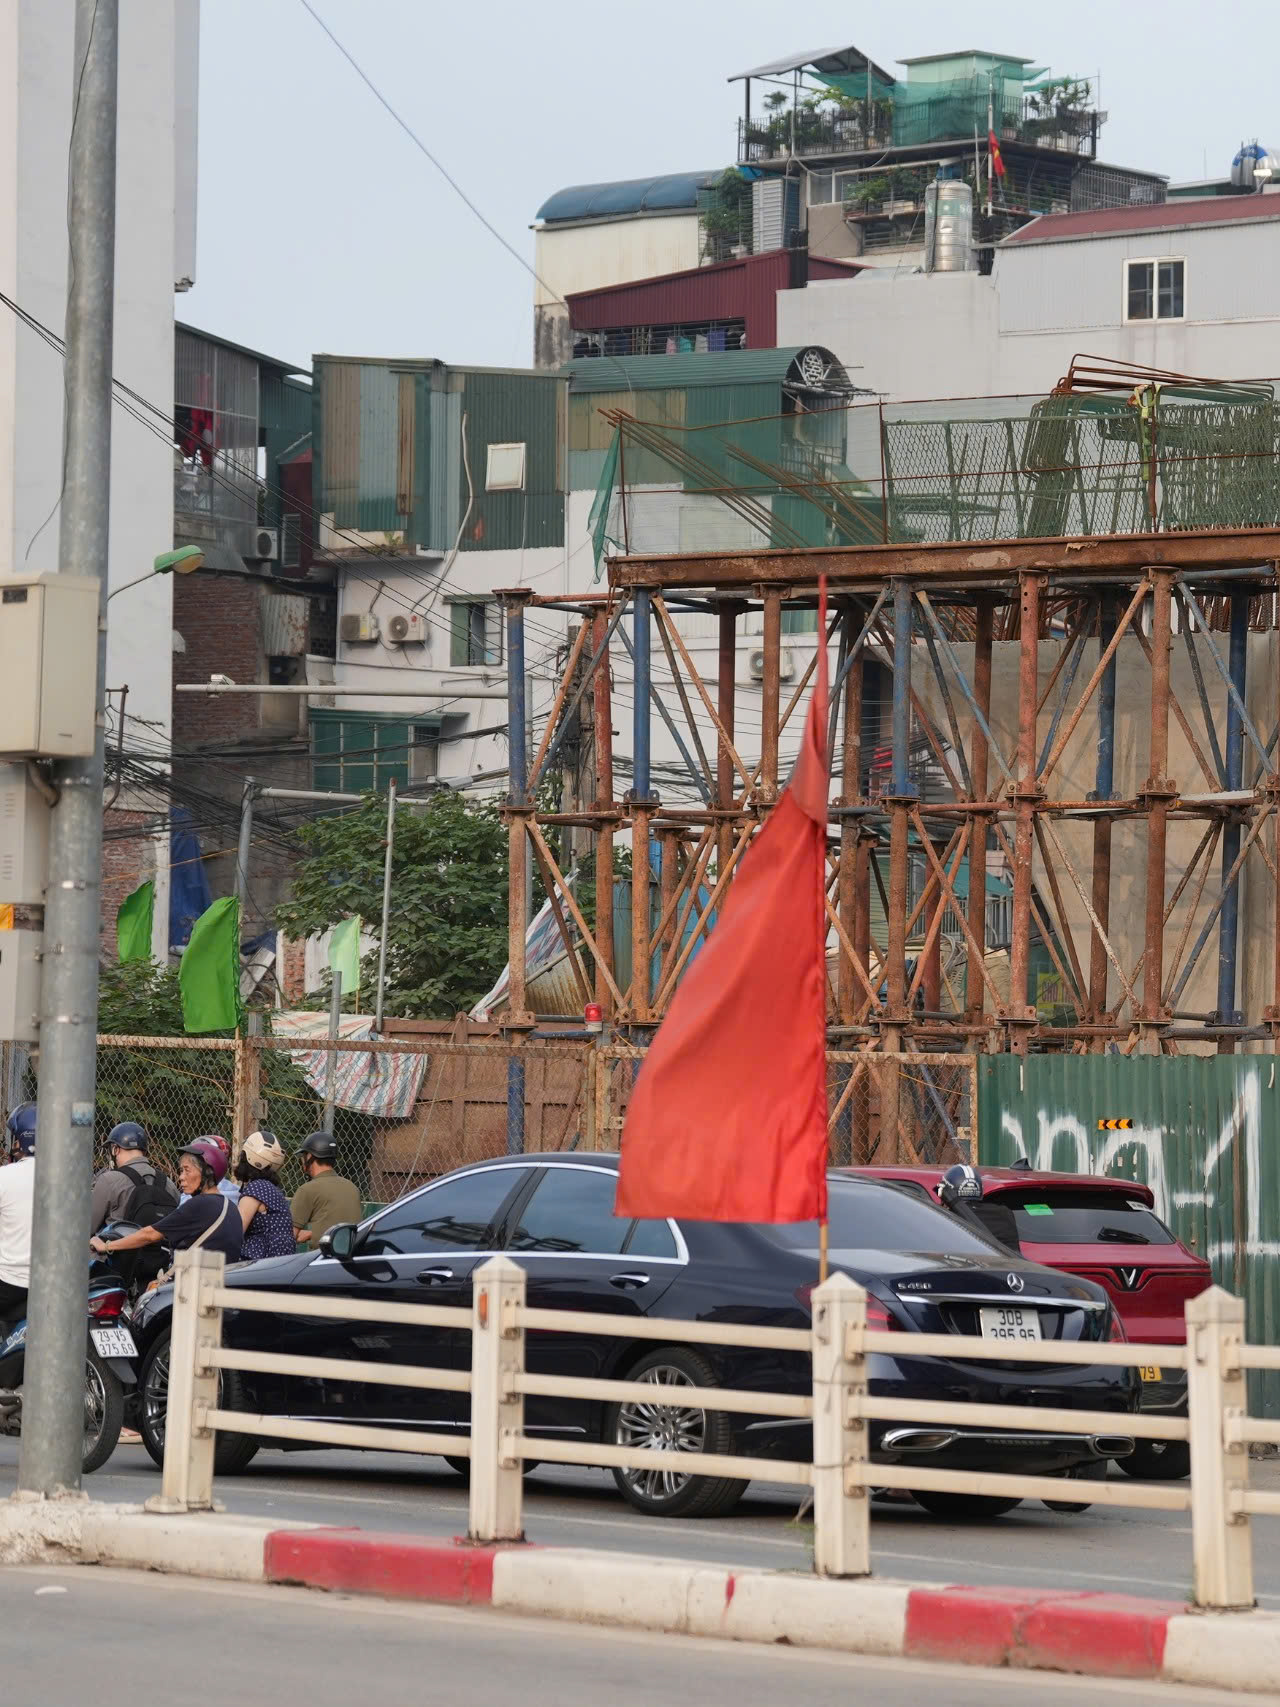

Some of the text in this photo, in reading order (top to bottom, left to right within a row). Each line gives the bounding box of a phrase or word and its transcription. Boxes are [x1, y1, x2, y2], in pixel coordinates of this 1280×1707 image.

[997, 1310, 1023, 1326] 30B
[97, 1330, 127, 1342] 29-V5
[990, 1328, 1036, 1340] 39595
